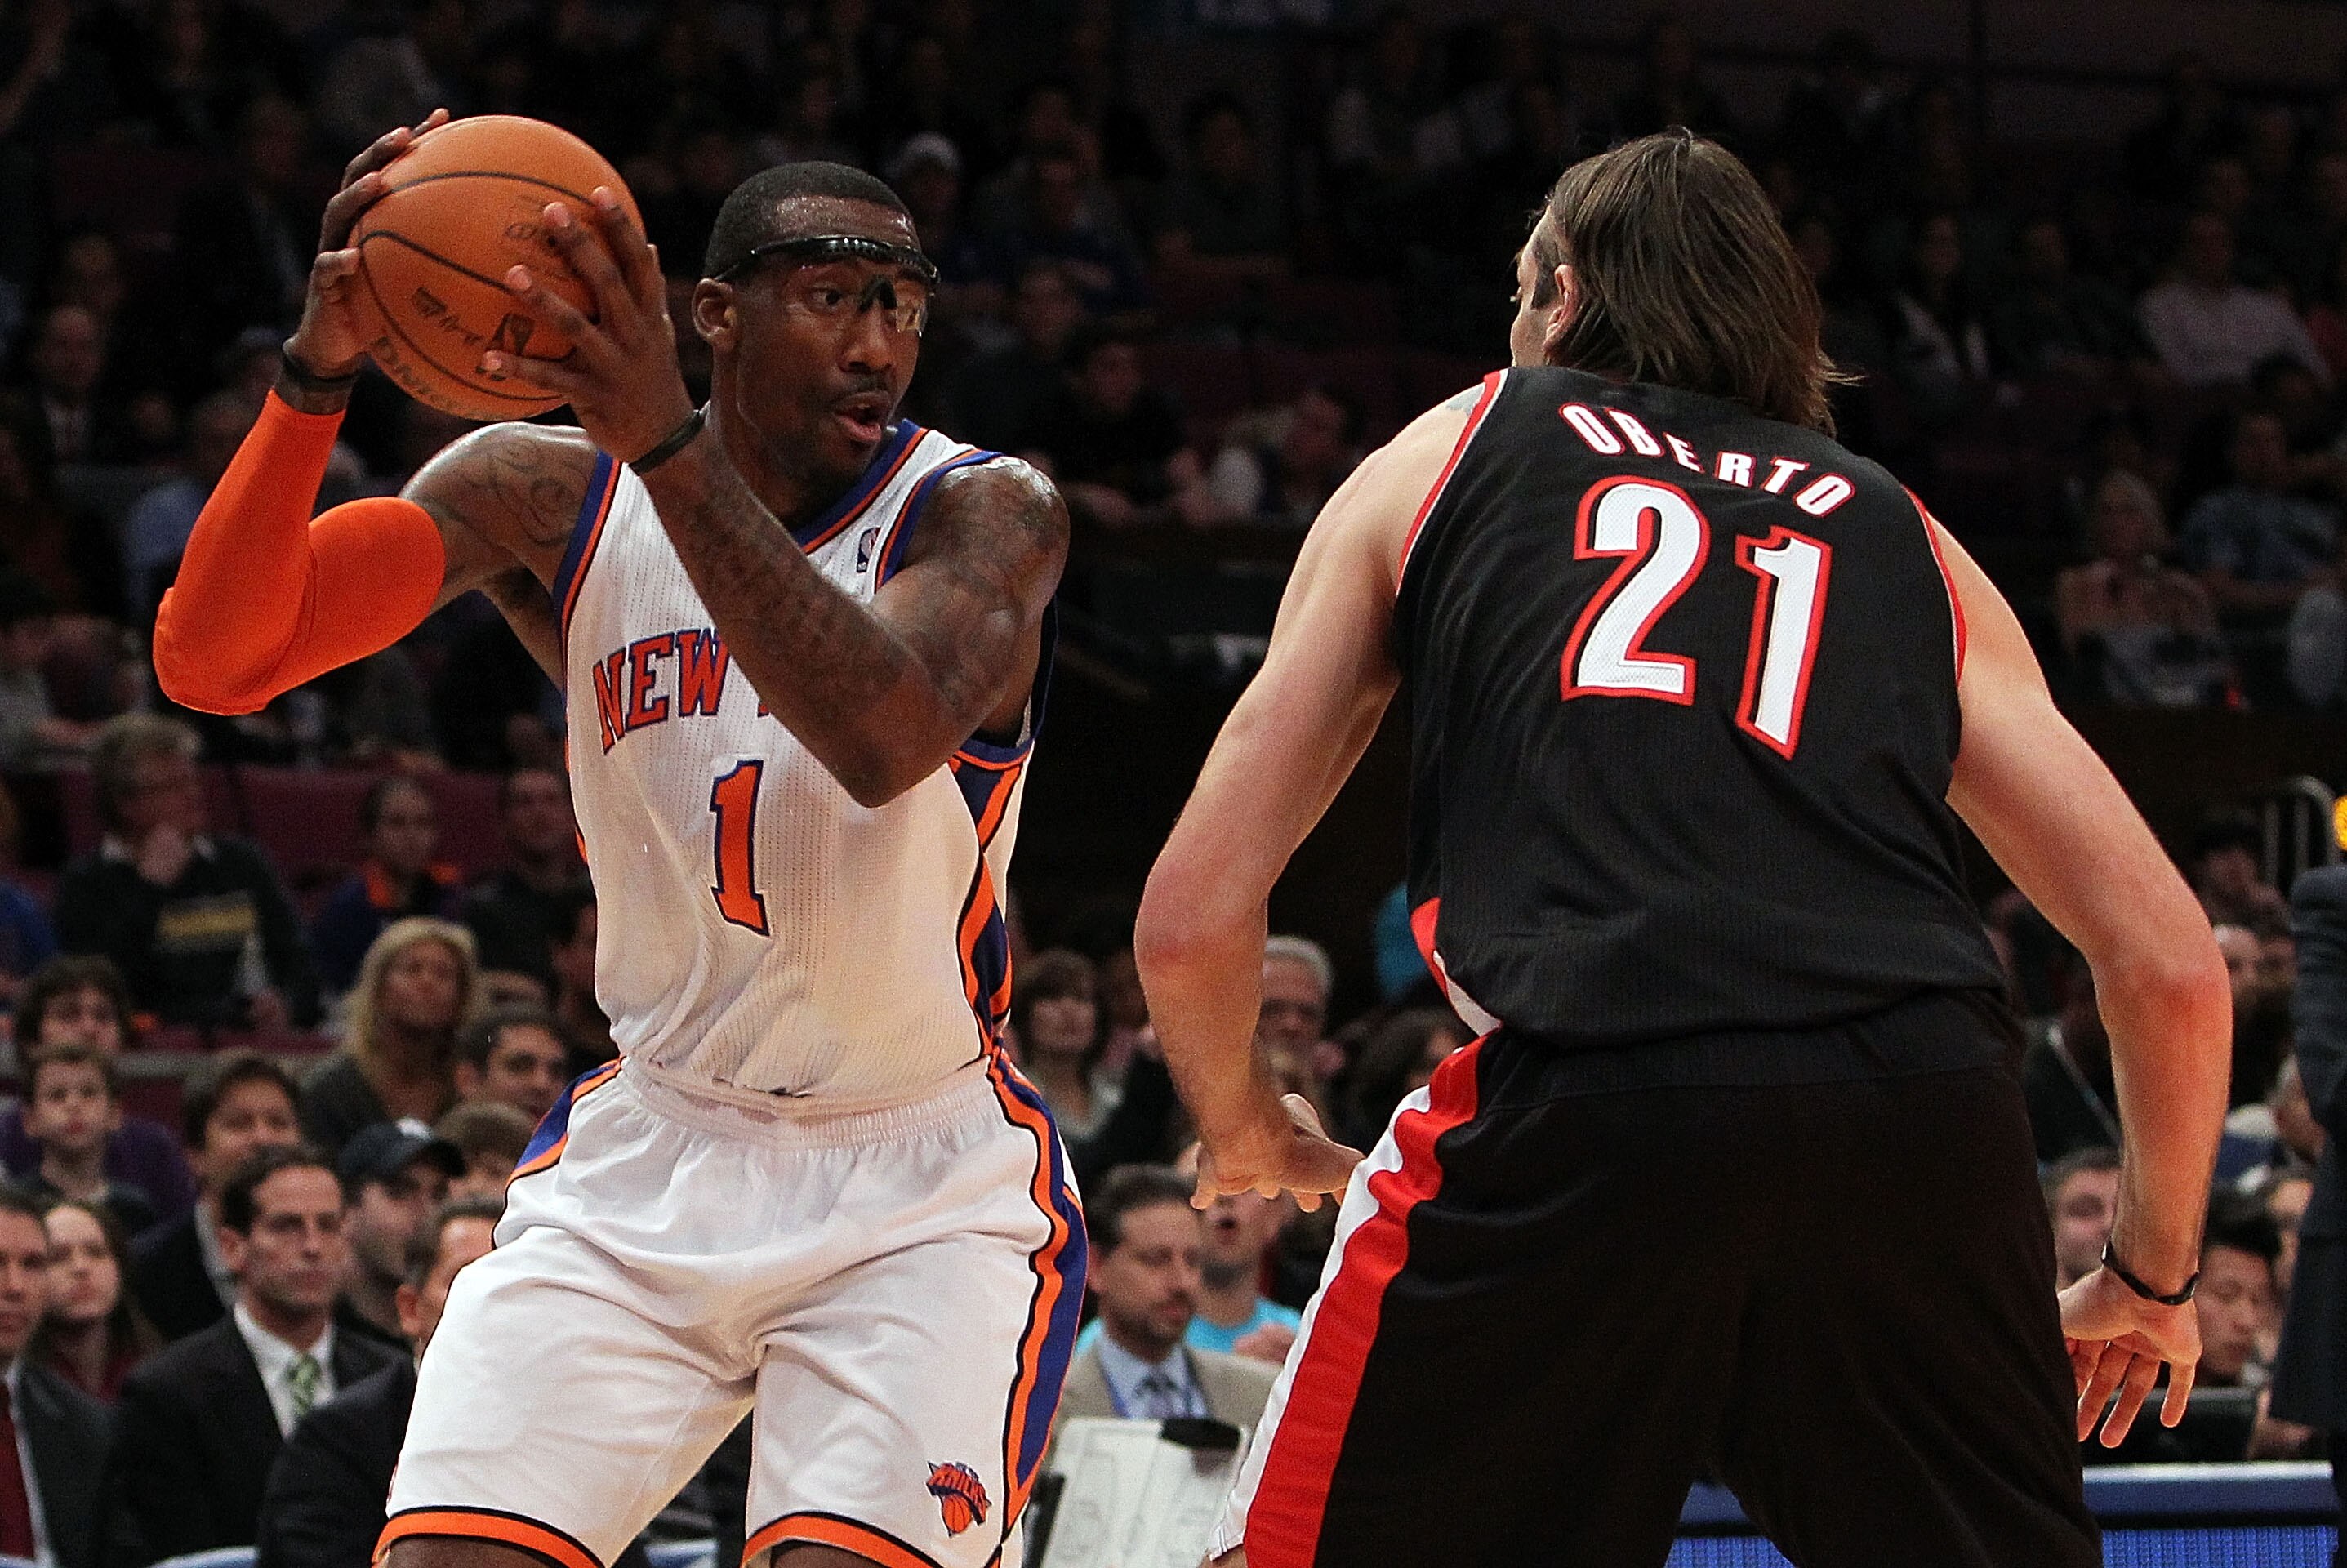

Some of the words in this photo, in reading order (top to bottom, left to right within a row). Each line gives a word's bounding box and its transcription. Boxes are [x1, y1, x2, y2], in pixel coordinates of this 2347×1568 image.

[1558, 401, 1857, 519] OBERTO
[593, 627, 729, 755] NEW
[1558, 474, 1834, 762] 21
[709, 760, 770, 937] 1
